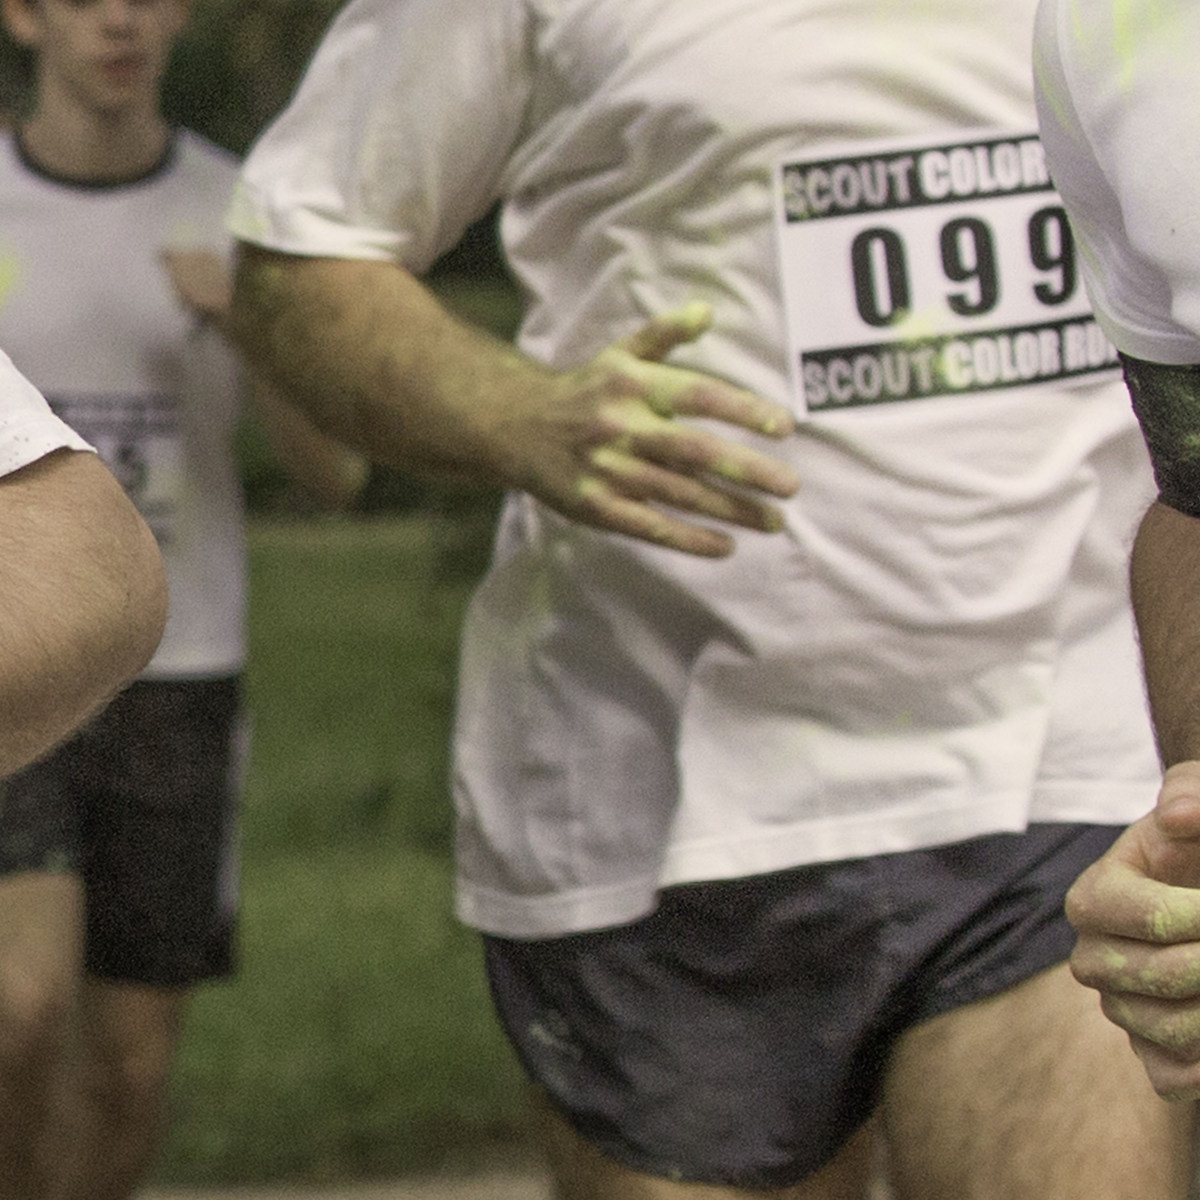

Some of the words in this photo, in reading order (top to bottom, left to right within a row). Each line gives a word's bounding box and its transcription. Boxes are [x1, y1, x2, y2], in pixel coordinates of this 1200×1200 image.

[784, 157, 913, 215] SCOUT
[918, 139, 1049, 199] COLOR
[803, 348, 938, 405] SCOUT
[941, 329, 1060, 388] COLOR
